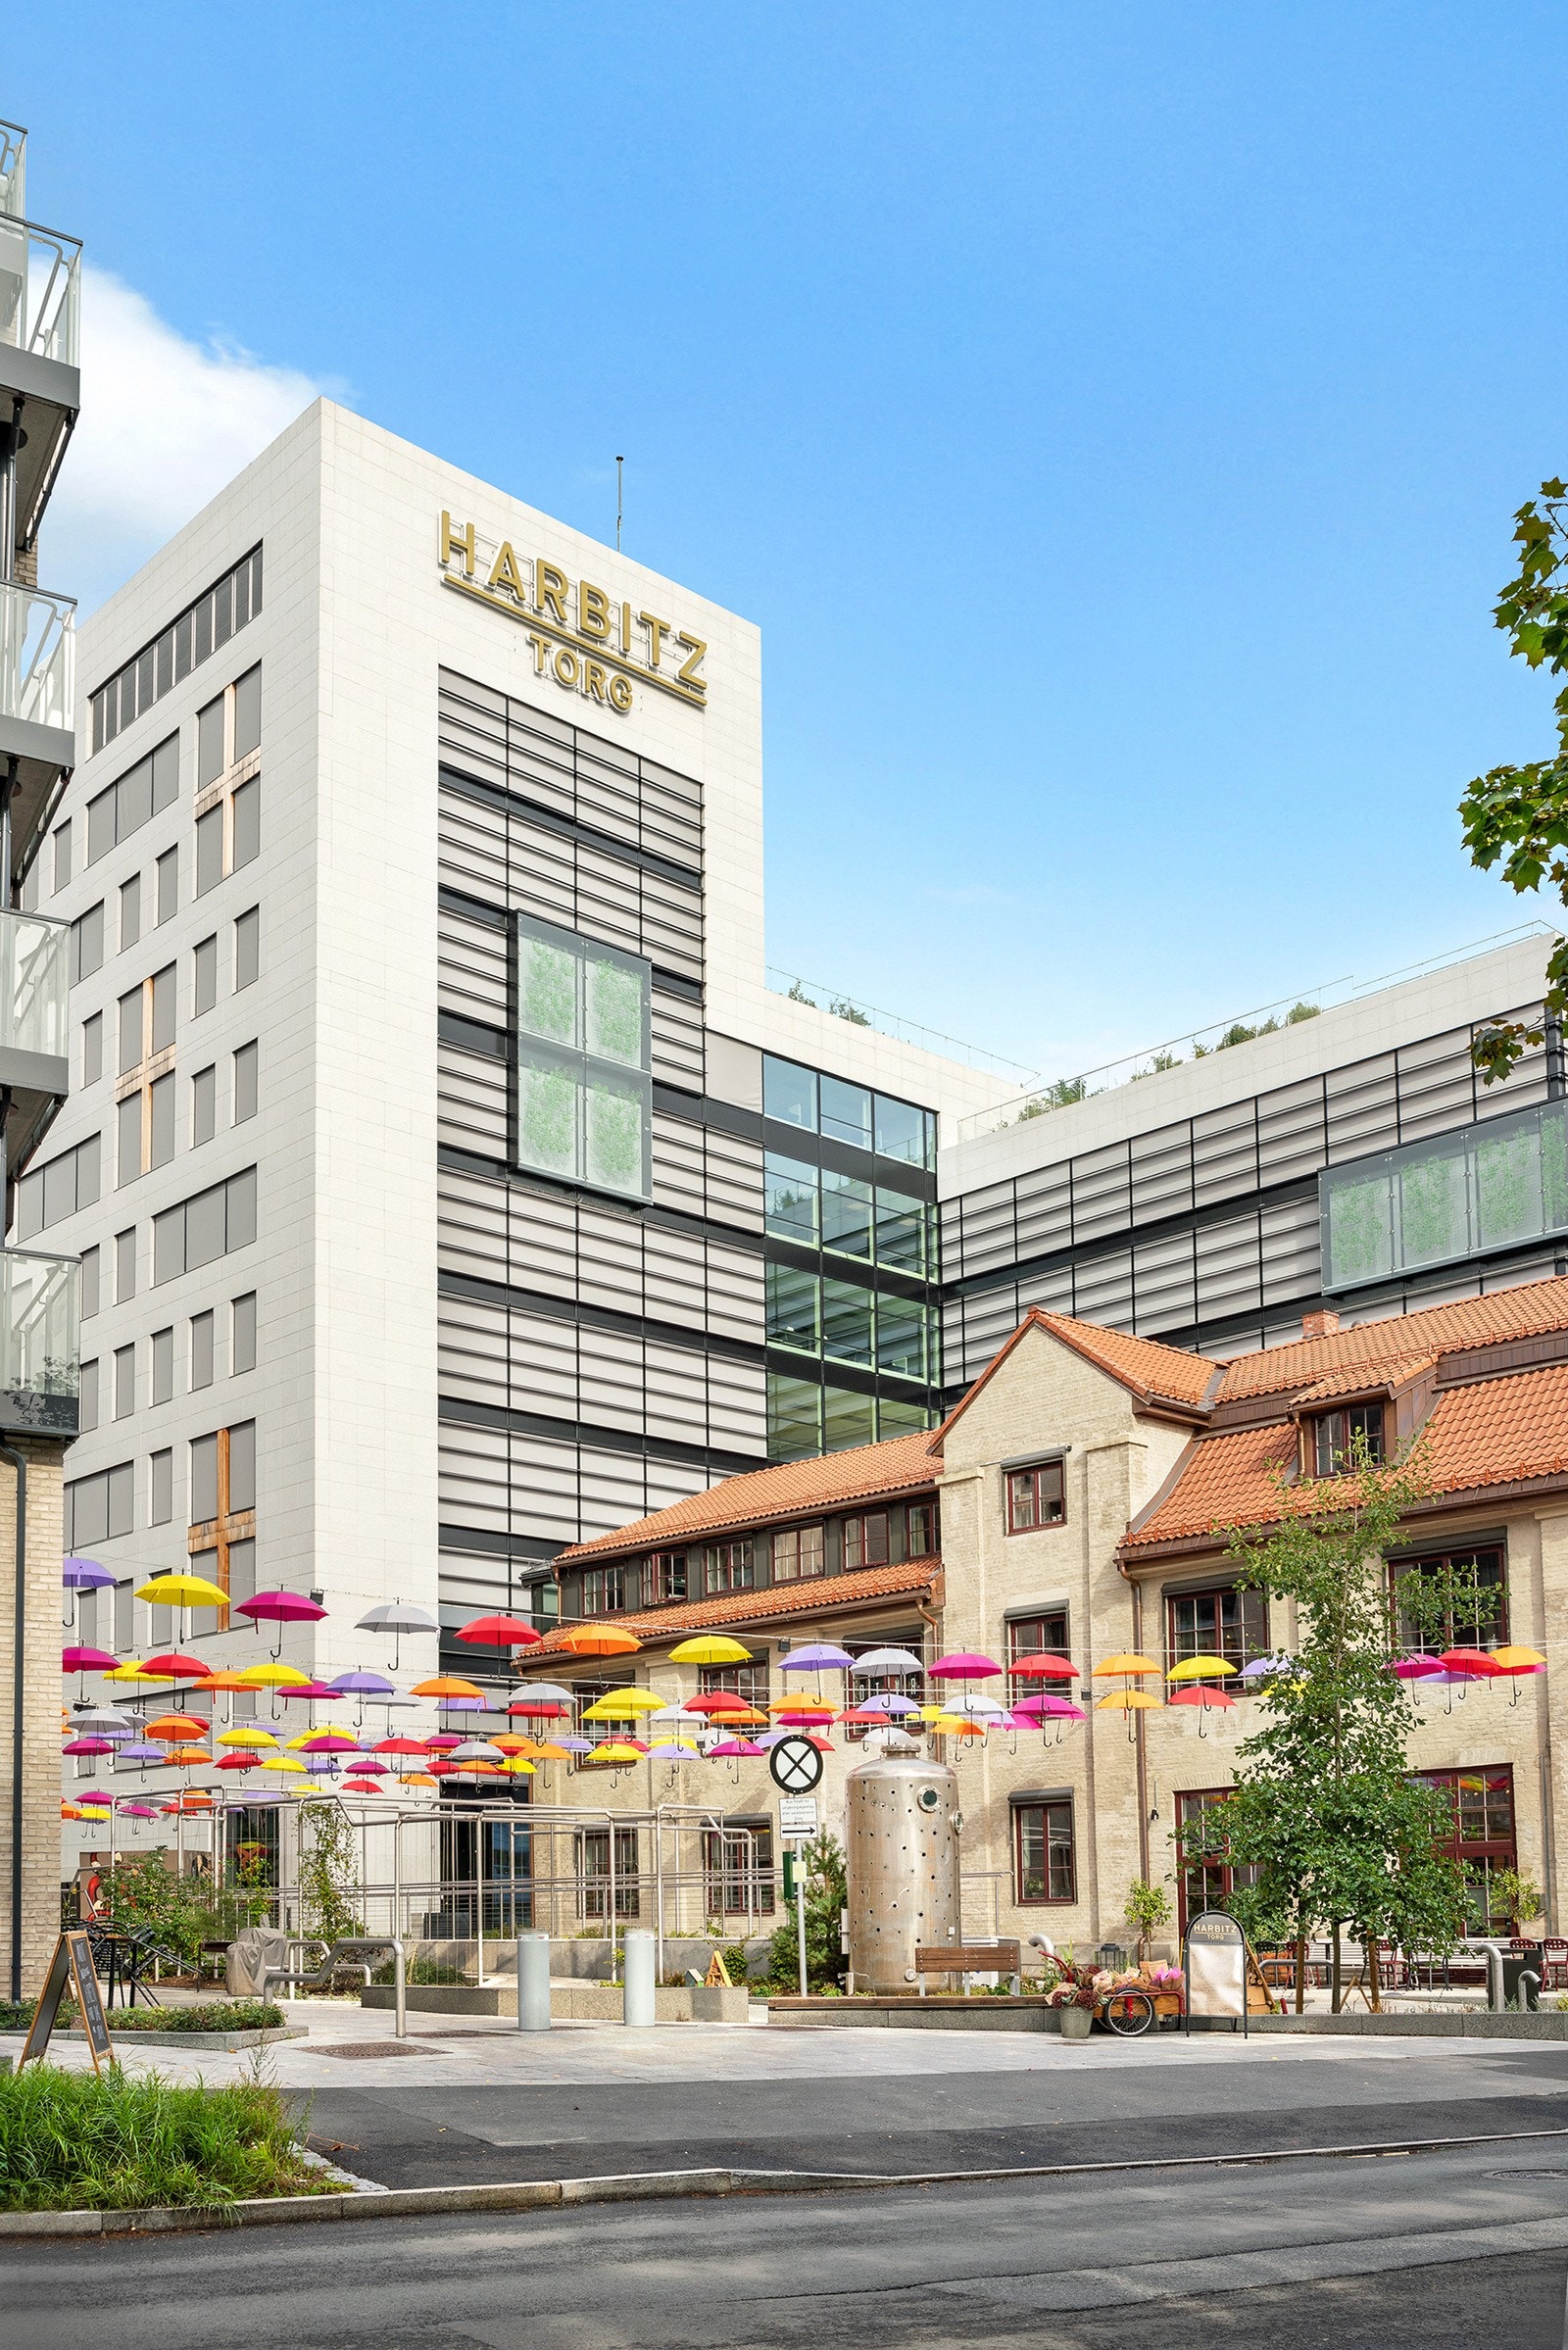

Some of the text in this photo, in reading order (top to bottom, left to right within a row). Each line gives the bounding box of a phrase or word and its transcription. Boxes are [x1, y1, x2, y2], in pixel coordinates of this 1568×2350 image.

[440, 510, 708, 690] HARBITZ
[528, 632, 633, 711] TORG
[1194, 1924, 1238, 1934] HARBITZ
